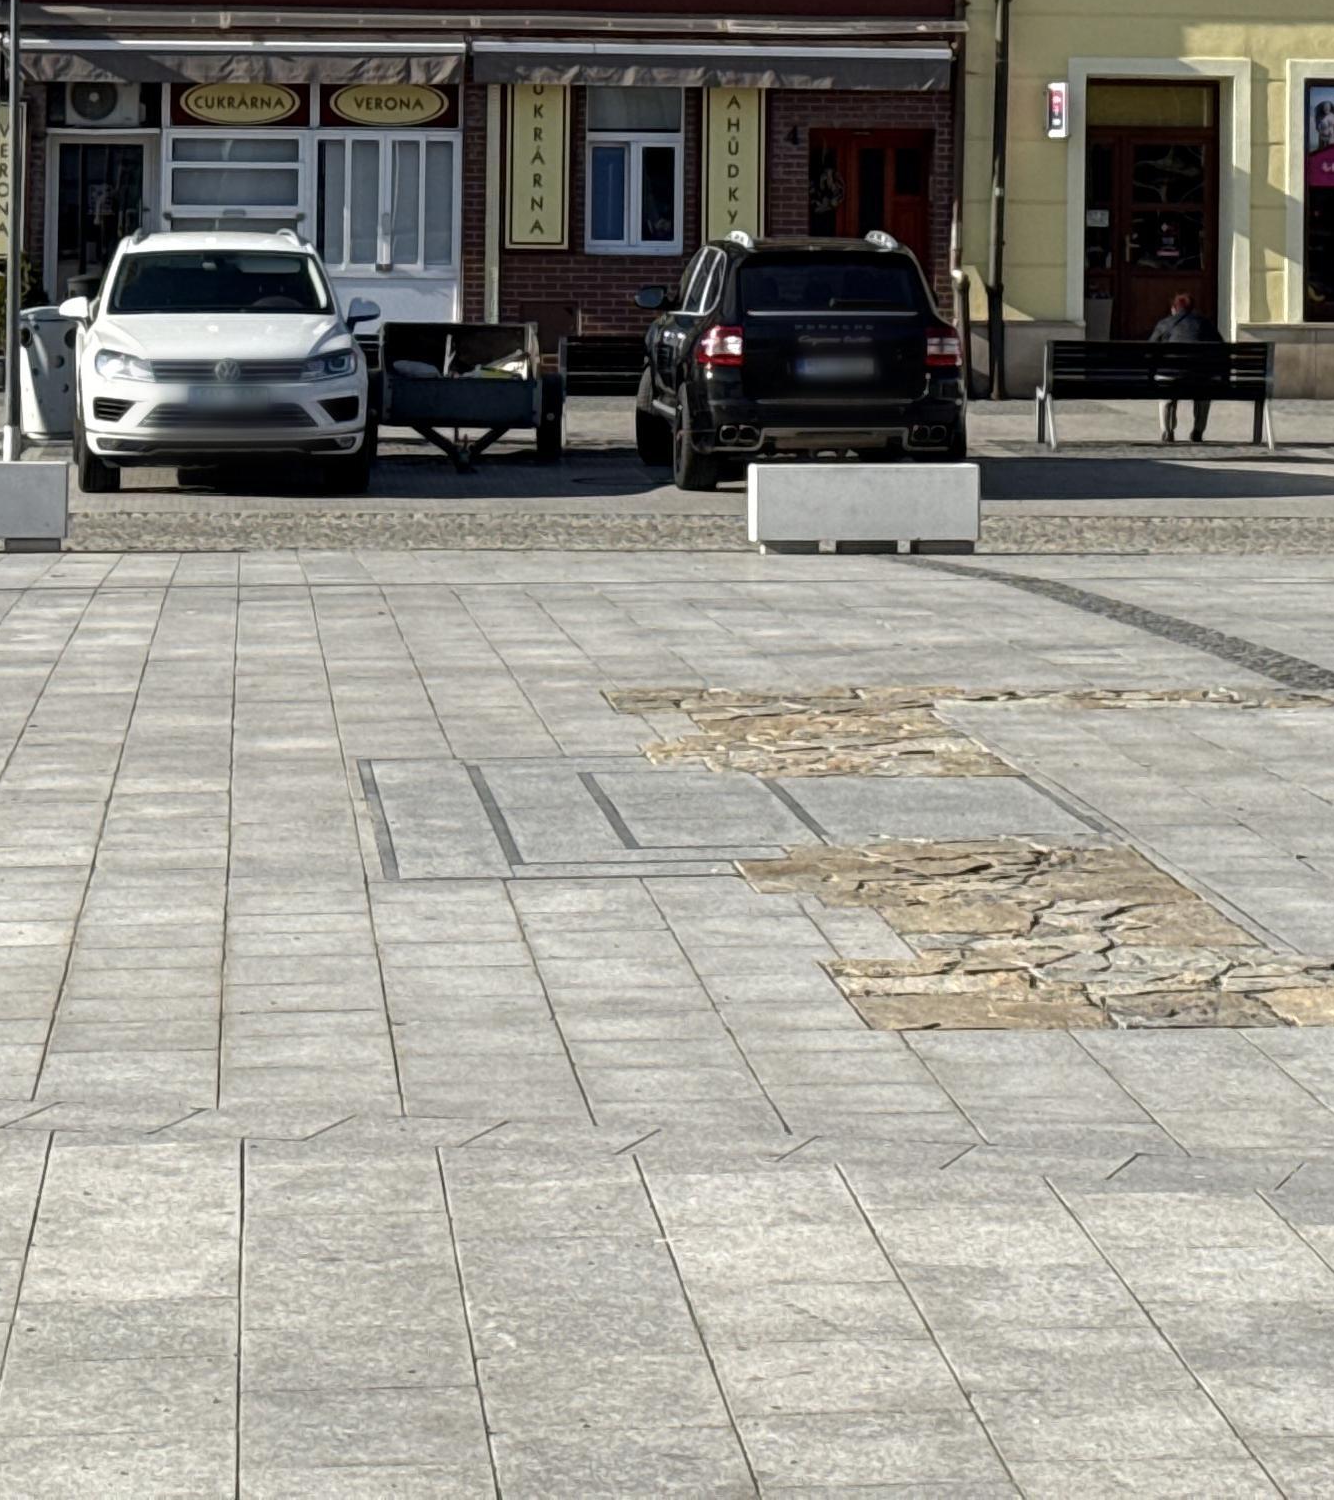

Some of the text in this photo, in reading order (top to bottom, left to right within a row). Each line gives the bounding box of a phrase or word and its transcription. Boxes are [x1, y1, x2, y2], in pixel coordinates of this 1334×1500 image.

[194, 92, 285, 110] CUKRÁRNA
[354, 97, 424, 110] VERONA
[787, 124, 799, 145] 4
[530, 85, 545, 235] UKRÁRNA
[727, 94, 741, 224] AHŮDKY
